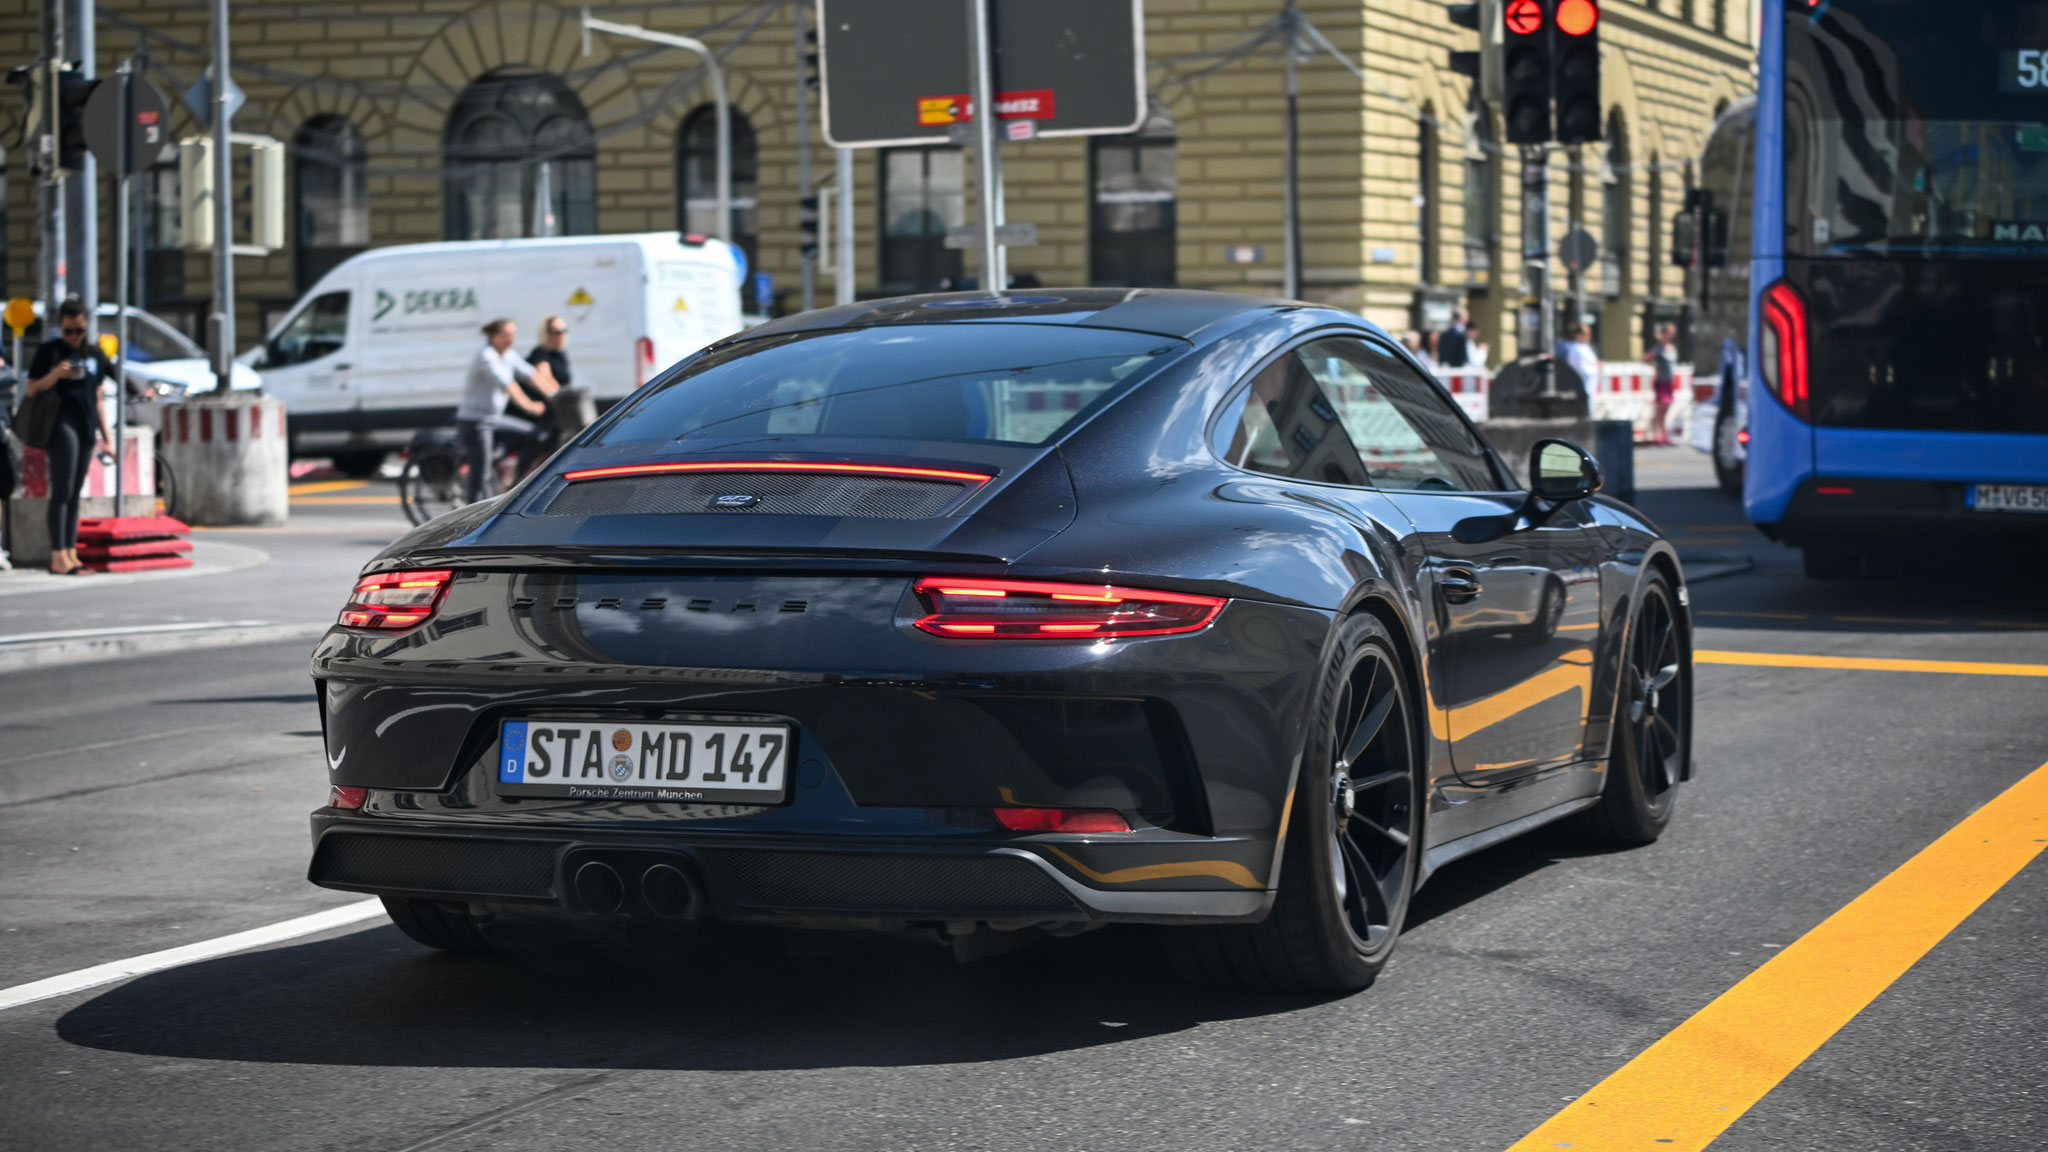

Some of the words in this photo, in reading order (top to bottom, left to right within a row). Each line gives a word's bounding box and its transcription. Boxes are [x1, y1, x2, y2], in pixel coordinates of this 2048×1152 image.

[1994, 224, 2048, 241] MA
[405, 288, 477, 314] DEKRA
[511, 598, 808, 613] PORSCHE
[528, 728, 603, 778] STA
[639, 731, 692, 780] MD
[703, 733, 783, 783] 147
[506, 759, 517, 773] D
[569, 786, 609, 798] Porsche
[613, 787, 654, 799] Zentrum
[657, 789, 703, 800] München
